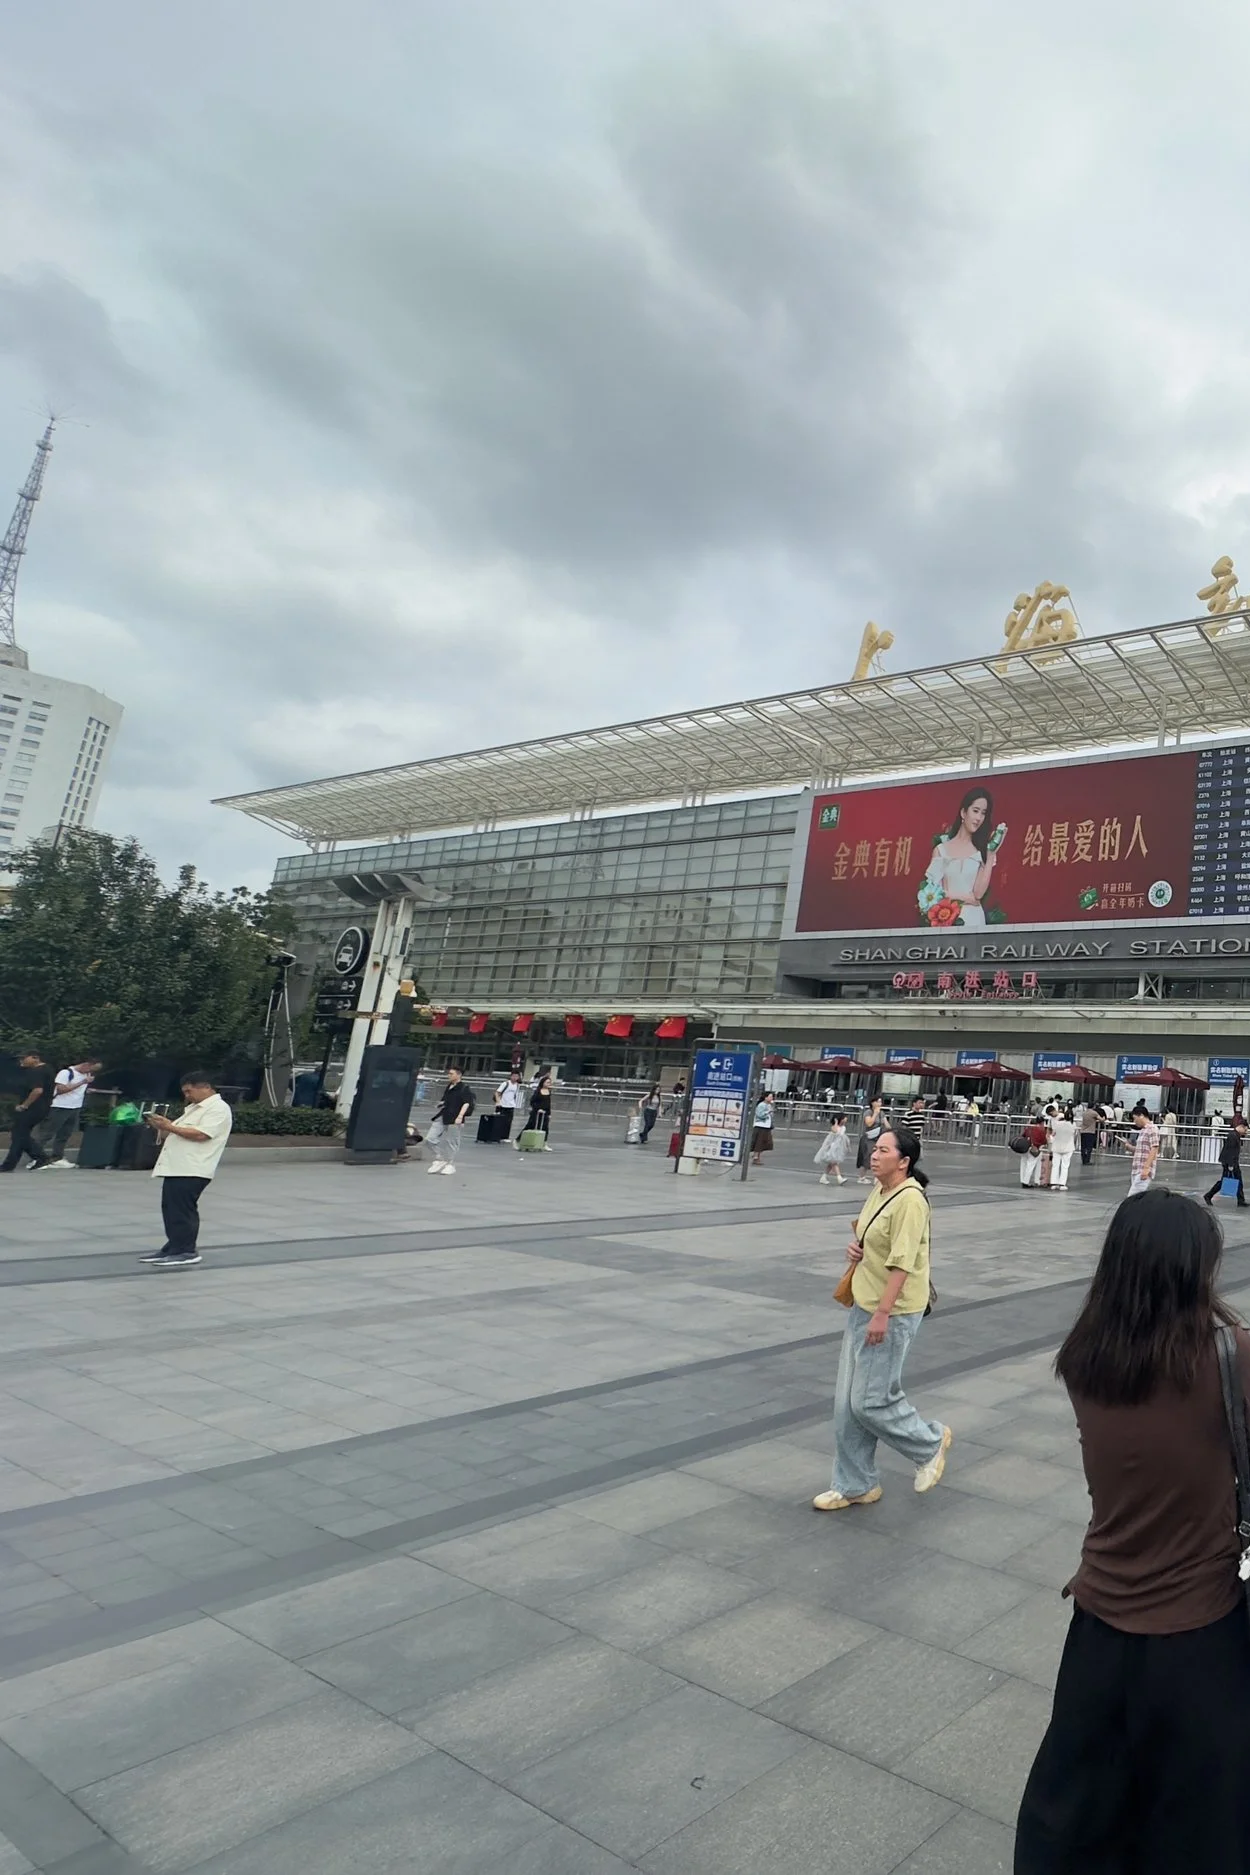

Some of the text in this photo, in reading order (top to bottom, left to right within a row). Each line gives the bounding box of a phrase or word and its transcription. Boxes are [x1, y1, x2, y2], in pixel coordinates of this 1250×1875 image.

[821, 806, 838, 823] 金典
[1022, 815, 1148, 867] 给最爱的人
[831, 836, 913, 880] 金典有机
[839, 944, 966, 961] SHANGHAI
[980, 940, 1111, 958] RAILWAY
[937, 970, 1038, 989] 南进站口
